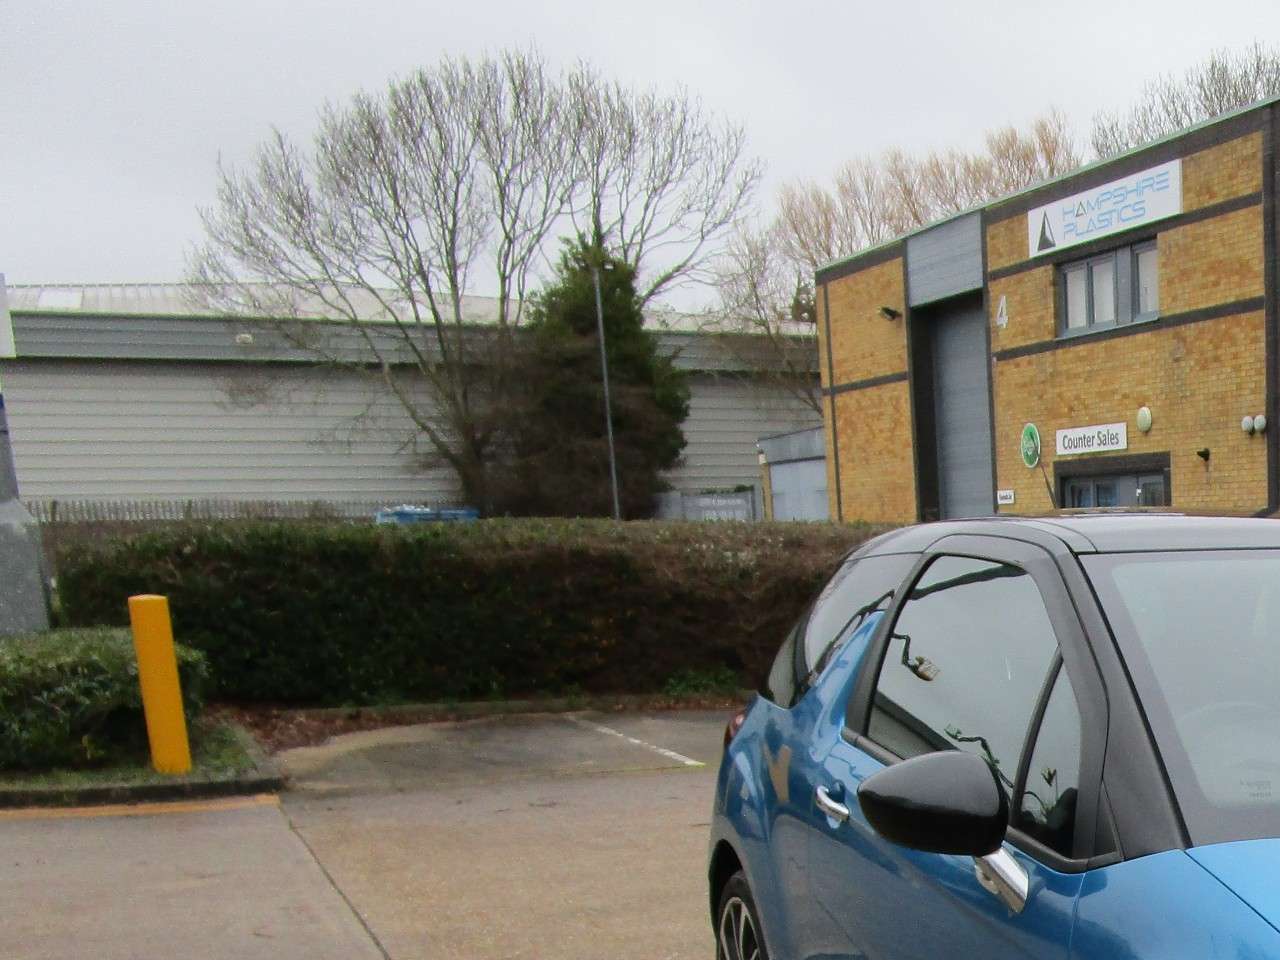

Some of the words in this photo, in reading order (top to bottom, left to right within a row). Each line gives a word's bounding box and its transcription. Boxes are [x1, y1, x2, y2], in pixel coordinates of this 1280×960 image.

[1062, 171, 1169, 222] HAMPSHIRE
[1063, 200, 1146, 241] PLASTICS
[996, 295, 1008, 329] 4
[1062, 433, 1096, 450] Counter
[1097, 429, 1120, 447] Sales
